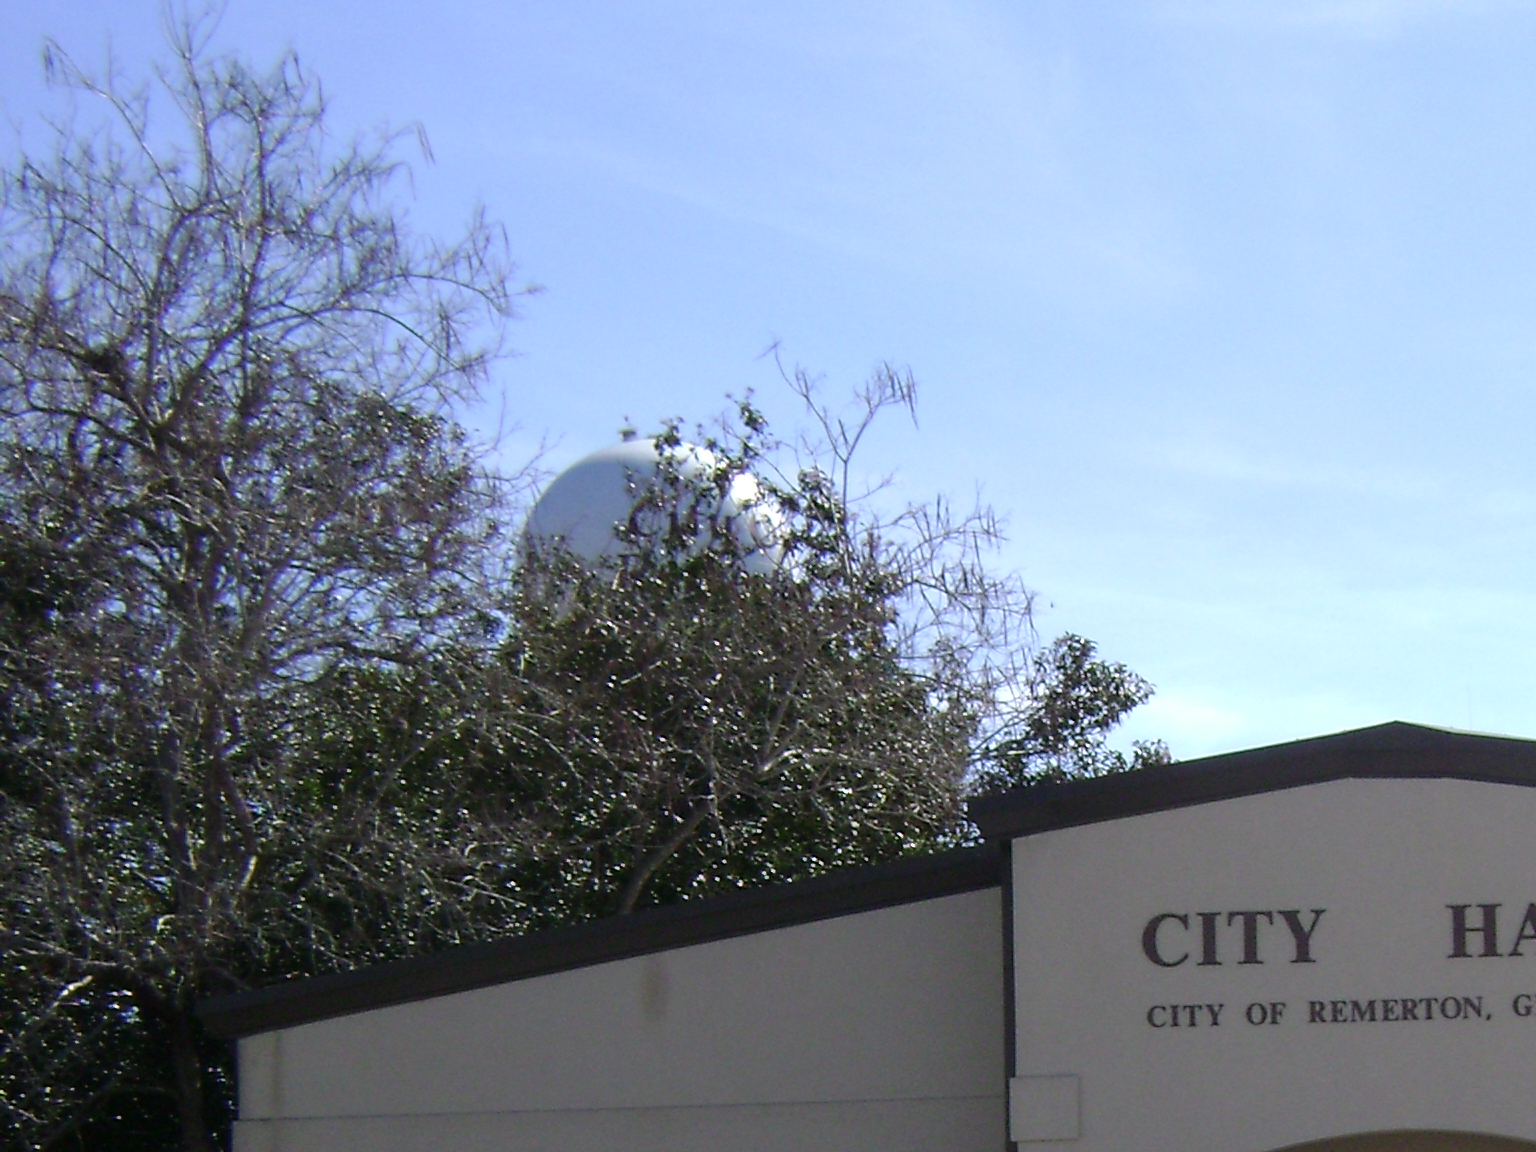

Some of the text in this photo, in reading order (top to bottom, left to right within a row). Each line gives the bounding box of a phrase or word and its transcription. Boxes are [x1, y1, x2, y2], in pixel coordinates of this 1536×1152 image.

[1140, 908, 1326, 968] CITY
[1146, 1002, 1225, 1029] CITY
[1245, 1001, 1287, 1027] OF
[1307, 995, 1493, 1024] REMERTON,
